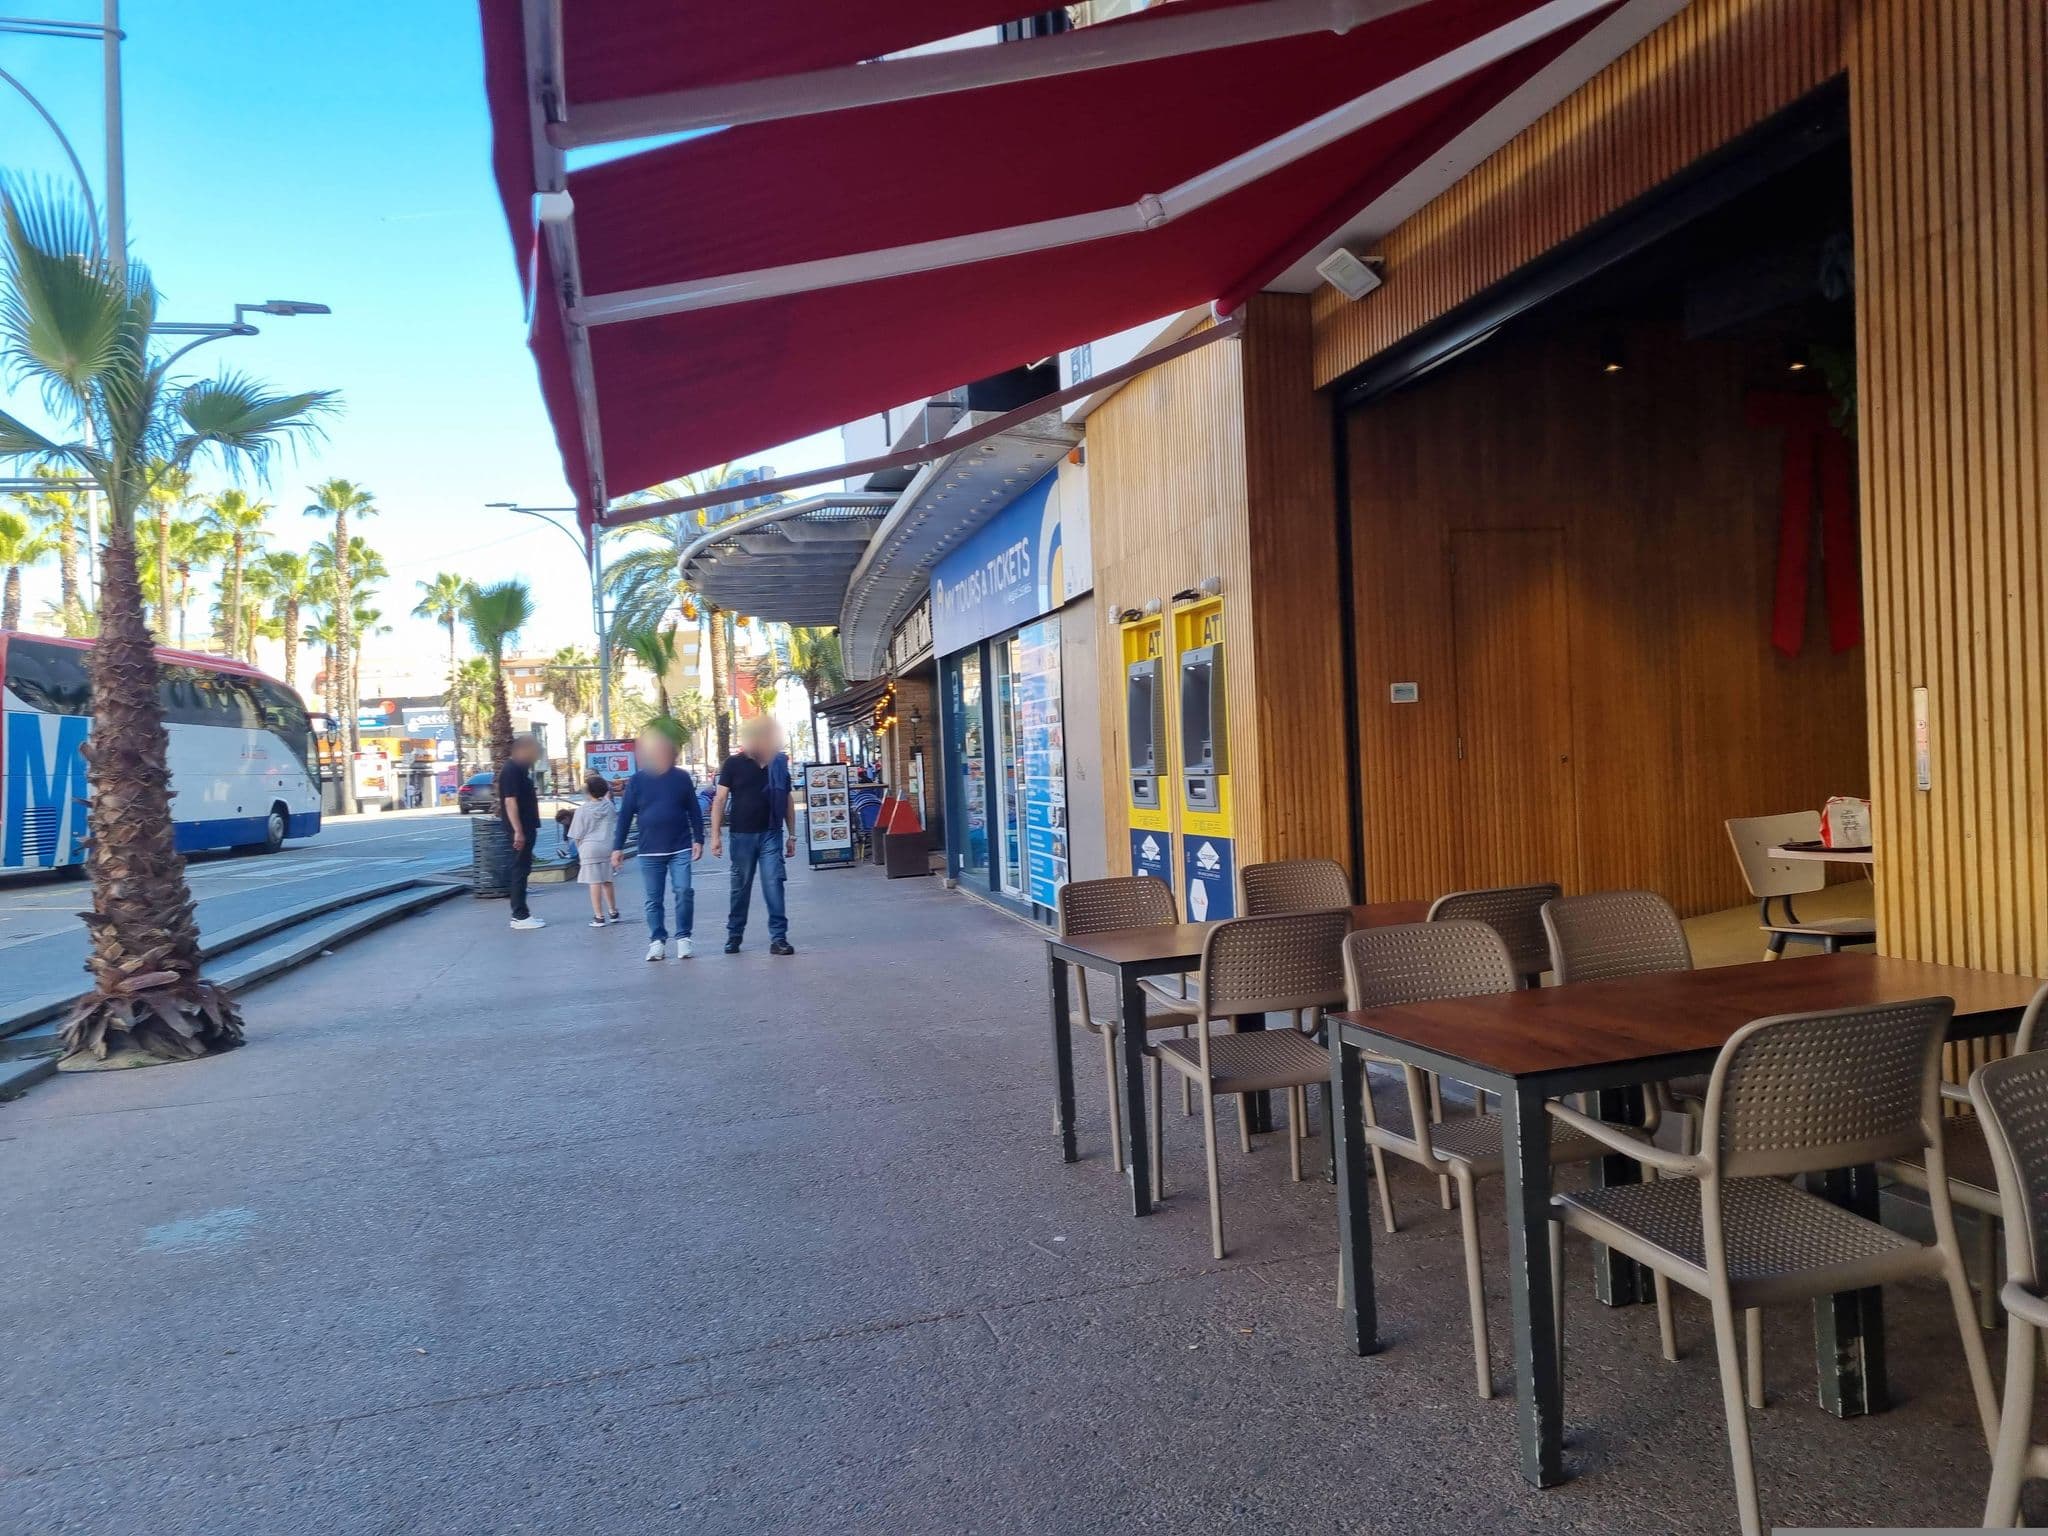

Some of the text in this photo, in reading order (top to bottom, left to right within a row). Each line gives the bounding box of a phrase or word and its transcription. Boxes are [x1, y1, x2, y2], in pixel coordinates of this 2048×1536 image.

[987, 536, 1031, 595] TICKETS
[1148, 630, 1161, 657] AT
[1204, 613, 1224, 645] AT
